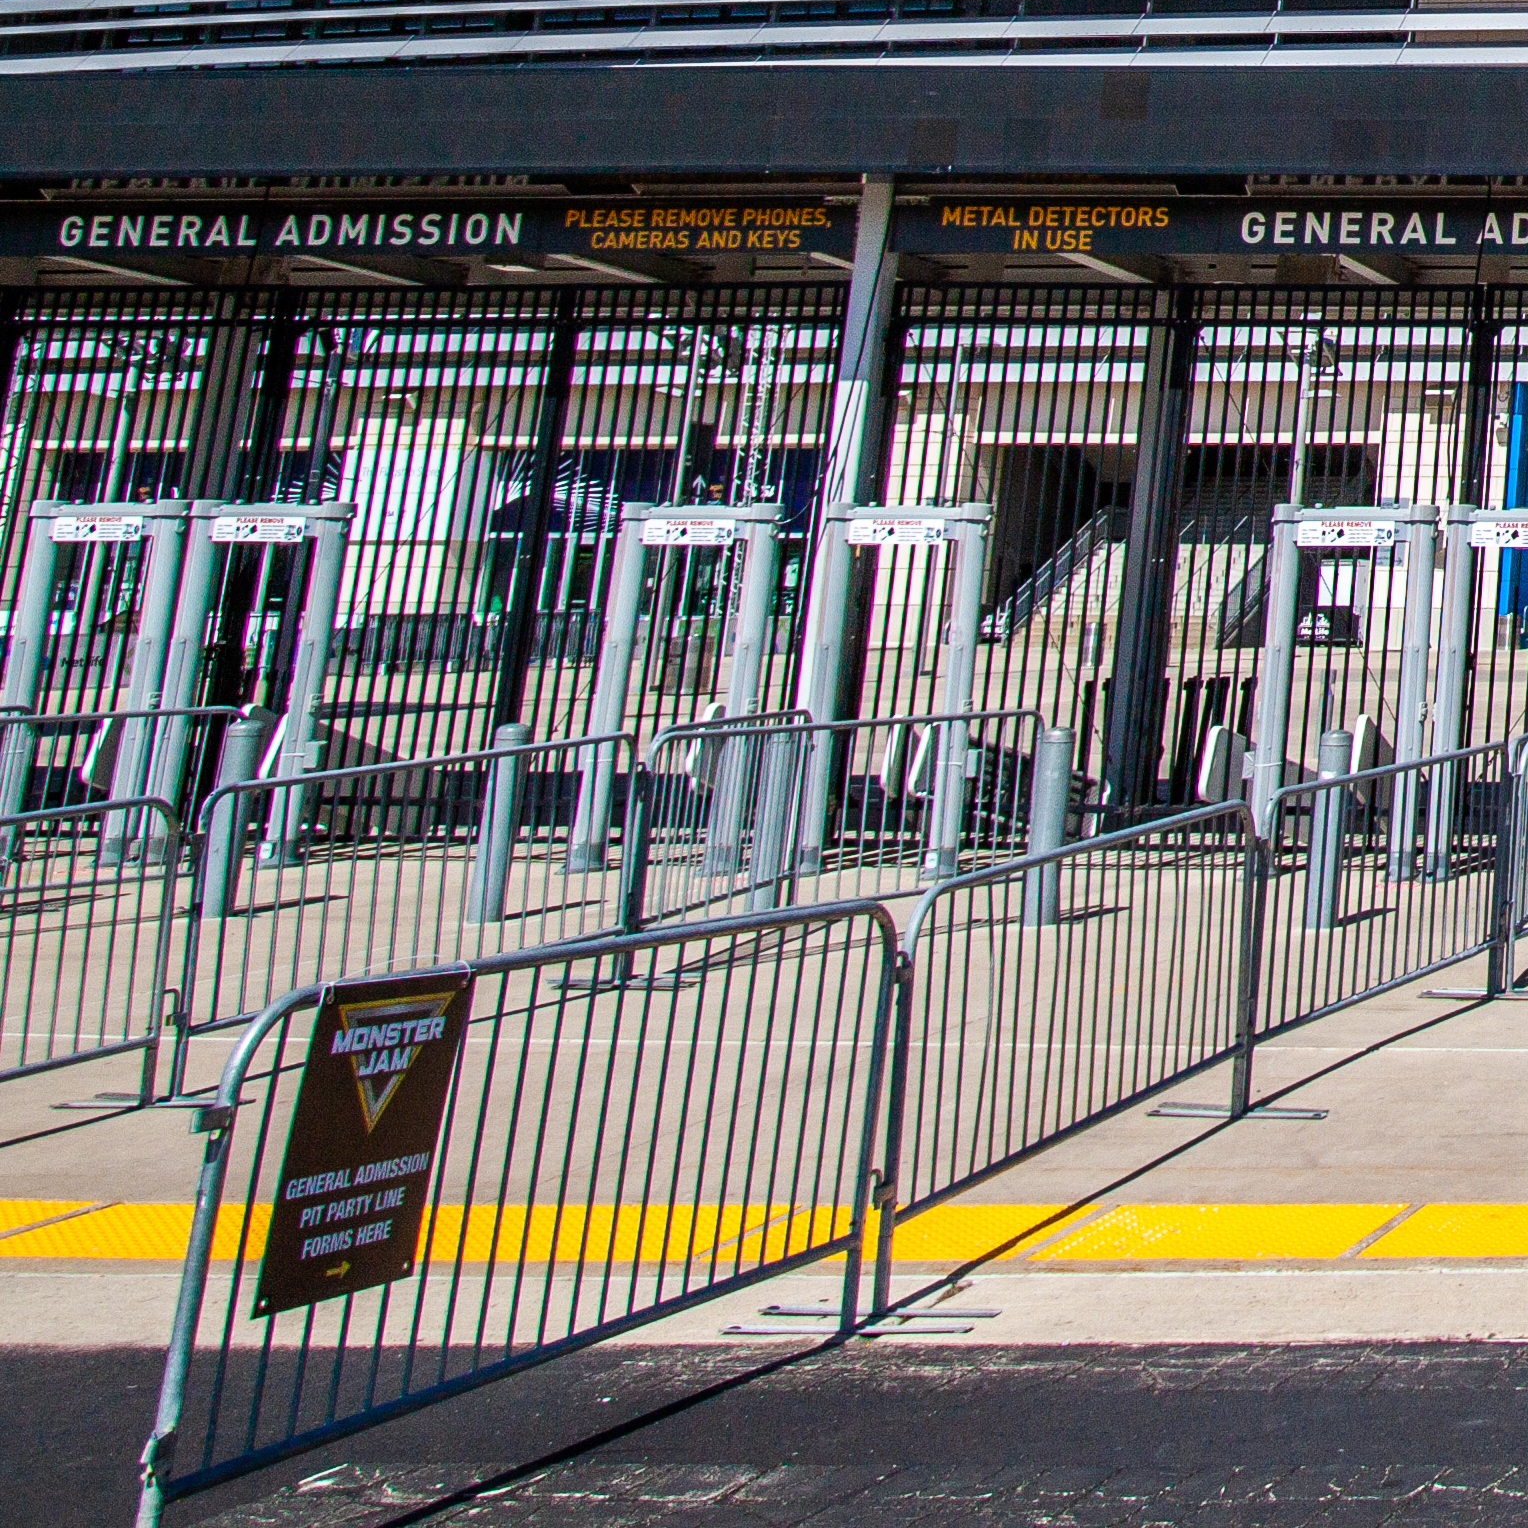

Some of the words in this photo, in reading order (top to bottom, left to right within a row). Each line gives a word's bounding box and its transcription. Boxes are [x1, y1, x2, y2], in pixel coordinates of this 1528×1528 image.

[58, 214, 258, 247] GENERAL
[275, 212, 524, 246] ADMISSION
[565, 209, 646, 228] PLEASE
[651, 208, 739, 228] REMOVE
[742, 207, 832, 229] PHONES,
[941, 206, 1020, 227] METAL
[1028, 206, 1169, 227] DETECTORS
[1241, 212, 1456, 245] GENERAL
[591, 230, 690, 249] CAMERAS
[695, 230, 743, 249] AND
[747, 229, 801, 248] KEYS
[1013, 230, 1038, 250] IN
[1046, 230, 1093, 250] USE
[330, 1016, 446, 1054] MONSTER
[358, 1046, 411, 1077] JAM
[285, 1169, 351, 1200] GENERAL
[353, 1152, 430, 1186] ADMISSION
[300, 1205, 325, 1228] PIT
[327, 1194, 374, 1223] PARTY
[375, 1186, 406, 1210] LINE
[301, 1228, 354, 1260] FORMS
[356, 1219, 392, 1247] HERE
